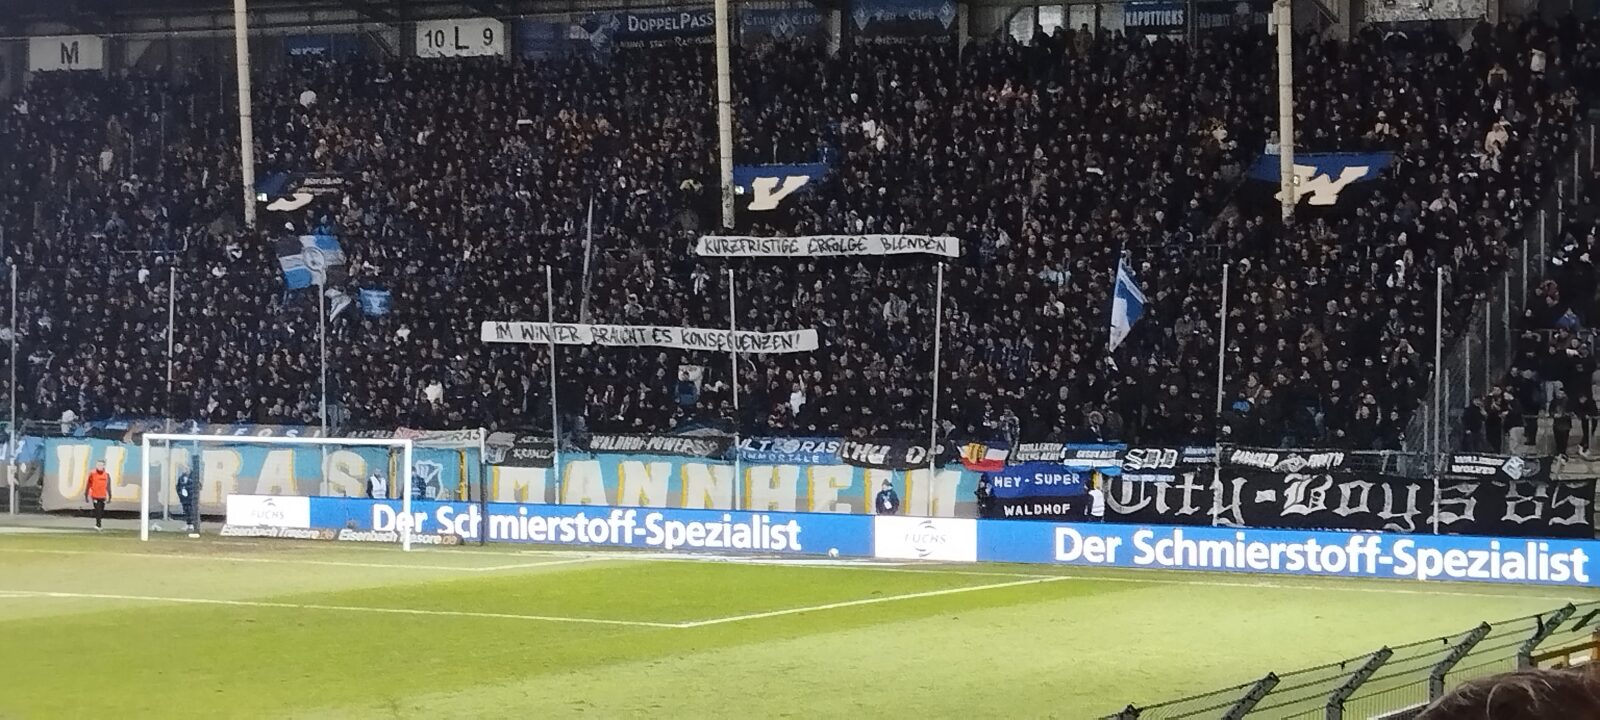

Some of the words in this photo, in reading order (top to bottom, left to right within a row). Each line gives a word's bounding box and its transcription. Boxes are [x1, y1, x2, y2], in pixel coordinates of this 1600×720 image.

[424, 29, 445, 48] 10
[455, 26, 469, 50] L
[482, 28, 494, 46] 9
[60, 41, 79, 65] M
[704, 238, 799, 255] KURZFRISTIGE
[807, 236, 868, 254] ERFOLGE
[880, 237, 947, 254] BLENDEN
[652, 328, 673, 344] ES
[681, 328, 801, 352] KONSEQUENZEN!
[57, 444, 367, 505] ULTRAS
[994, 475, 1024, 488] HEY
[1034, 472, 1081, 486] SUPER
[492, 460, 961, 517] MANNHEIM
[1003, 503, 1072, 517] WALDHOF
[372, 504, 428, 533] Der
[437, 506, 802, 553] Schmierstoff-Spezialist
[1054, 527, 1122, 564] Der
[1133, 529, 1590, 583] Schmierstoff-Spezialist
